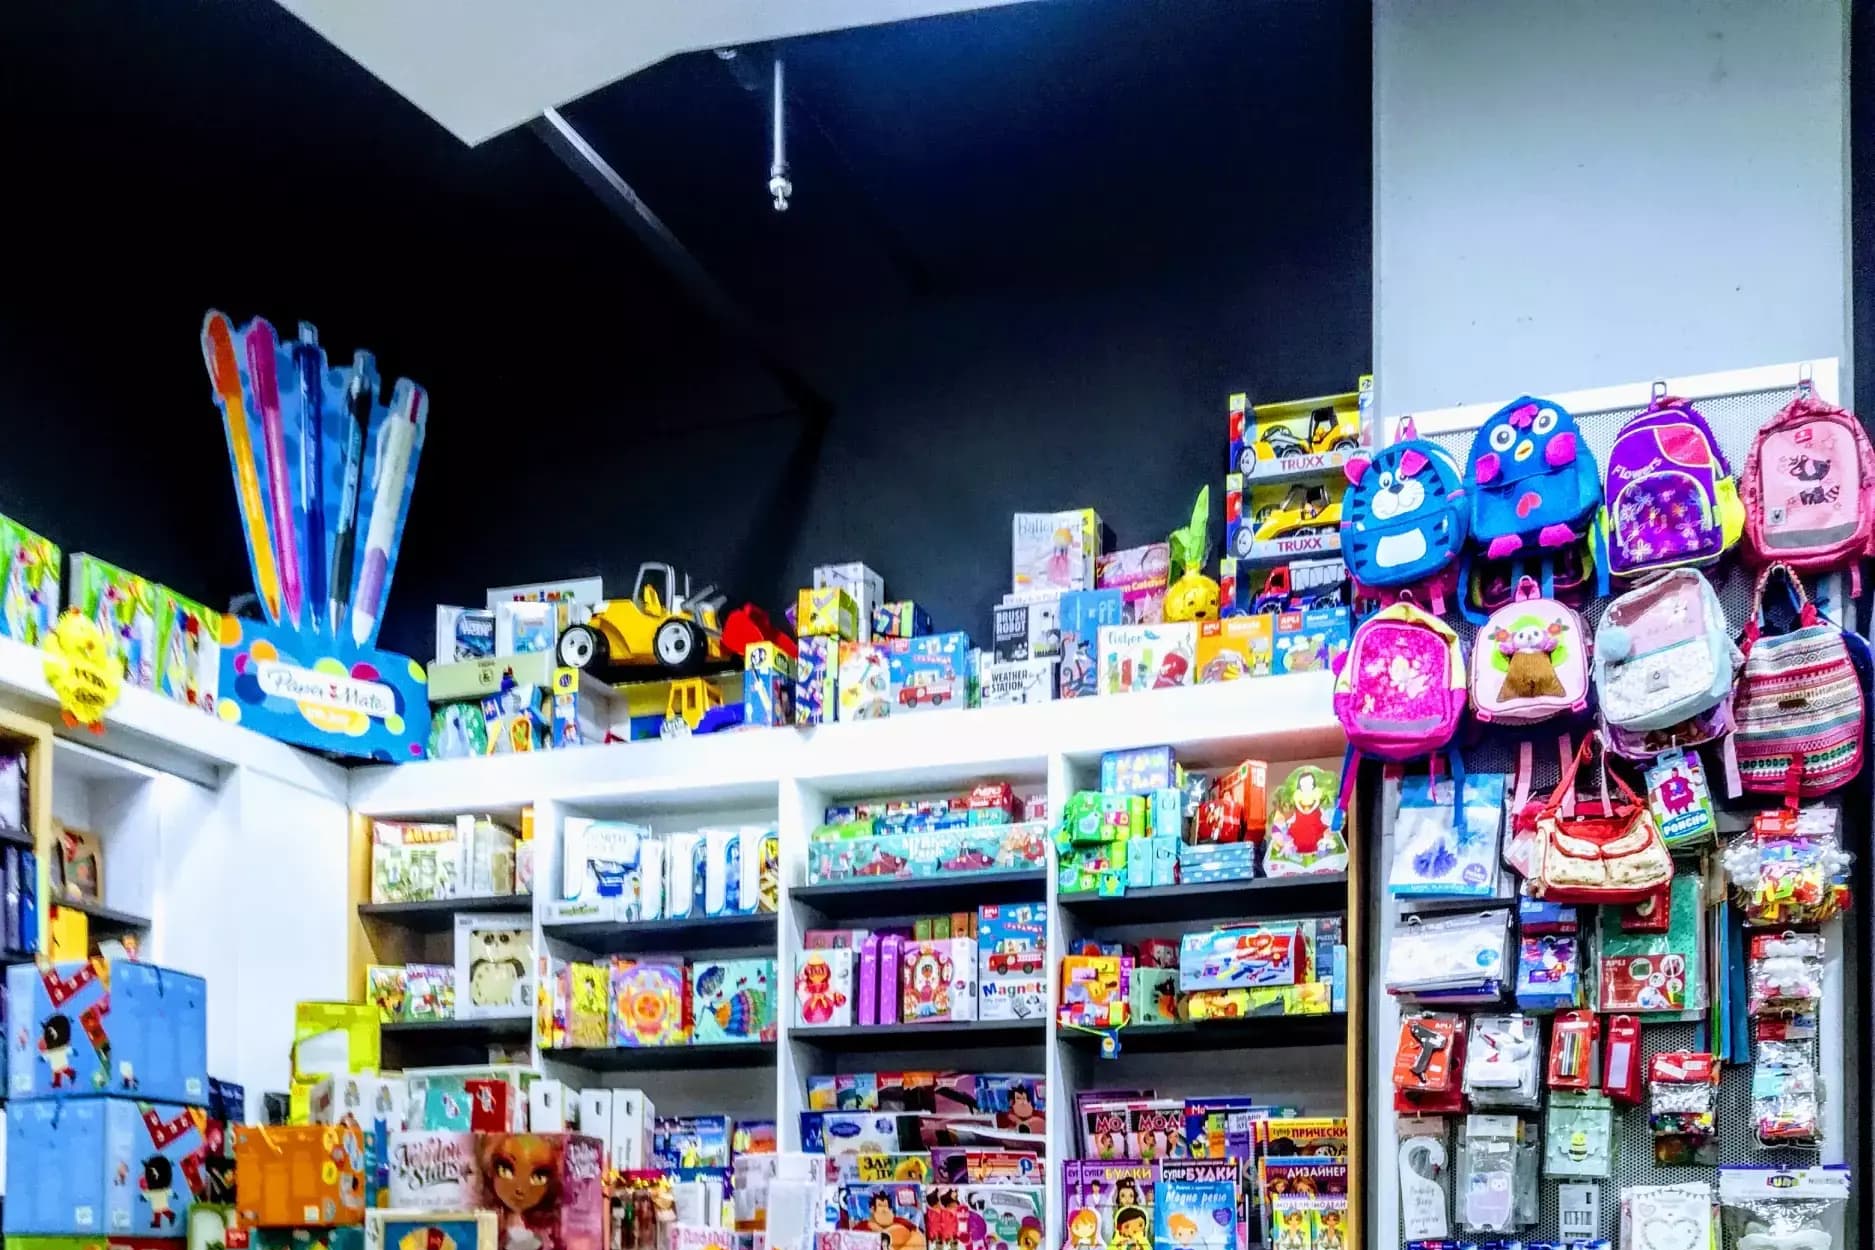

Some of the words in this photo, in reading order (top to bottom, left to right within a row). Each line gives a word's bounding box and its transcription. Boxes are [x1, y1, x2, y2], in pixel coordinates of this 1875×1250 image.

[1280, 454, 1325, 472] TRUXX
[1276, 536, 1323, 553] TRUXX
[995, 619, 1028, 634] ROBOT
[1279, 615, 1301, 626] APLI
[991, 668, 1028, 682] WEATHER
[991, 680, 1024, 693] STATION
[1663, 812, 1708, 836] PONCHO
[1291, 1127, 1348, 1139] ПРИЧЕСКИ
[1104, 1166, 1152, 1179] БУЛКИ
[1163, 1167, 1186, 1179] СУПЕР
[1185, 1166, 1238, 1182] БУЛКИ
[1287, 1165, 1347, 1179] ДИЗАЙНЕР
